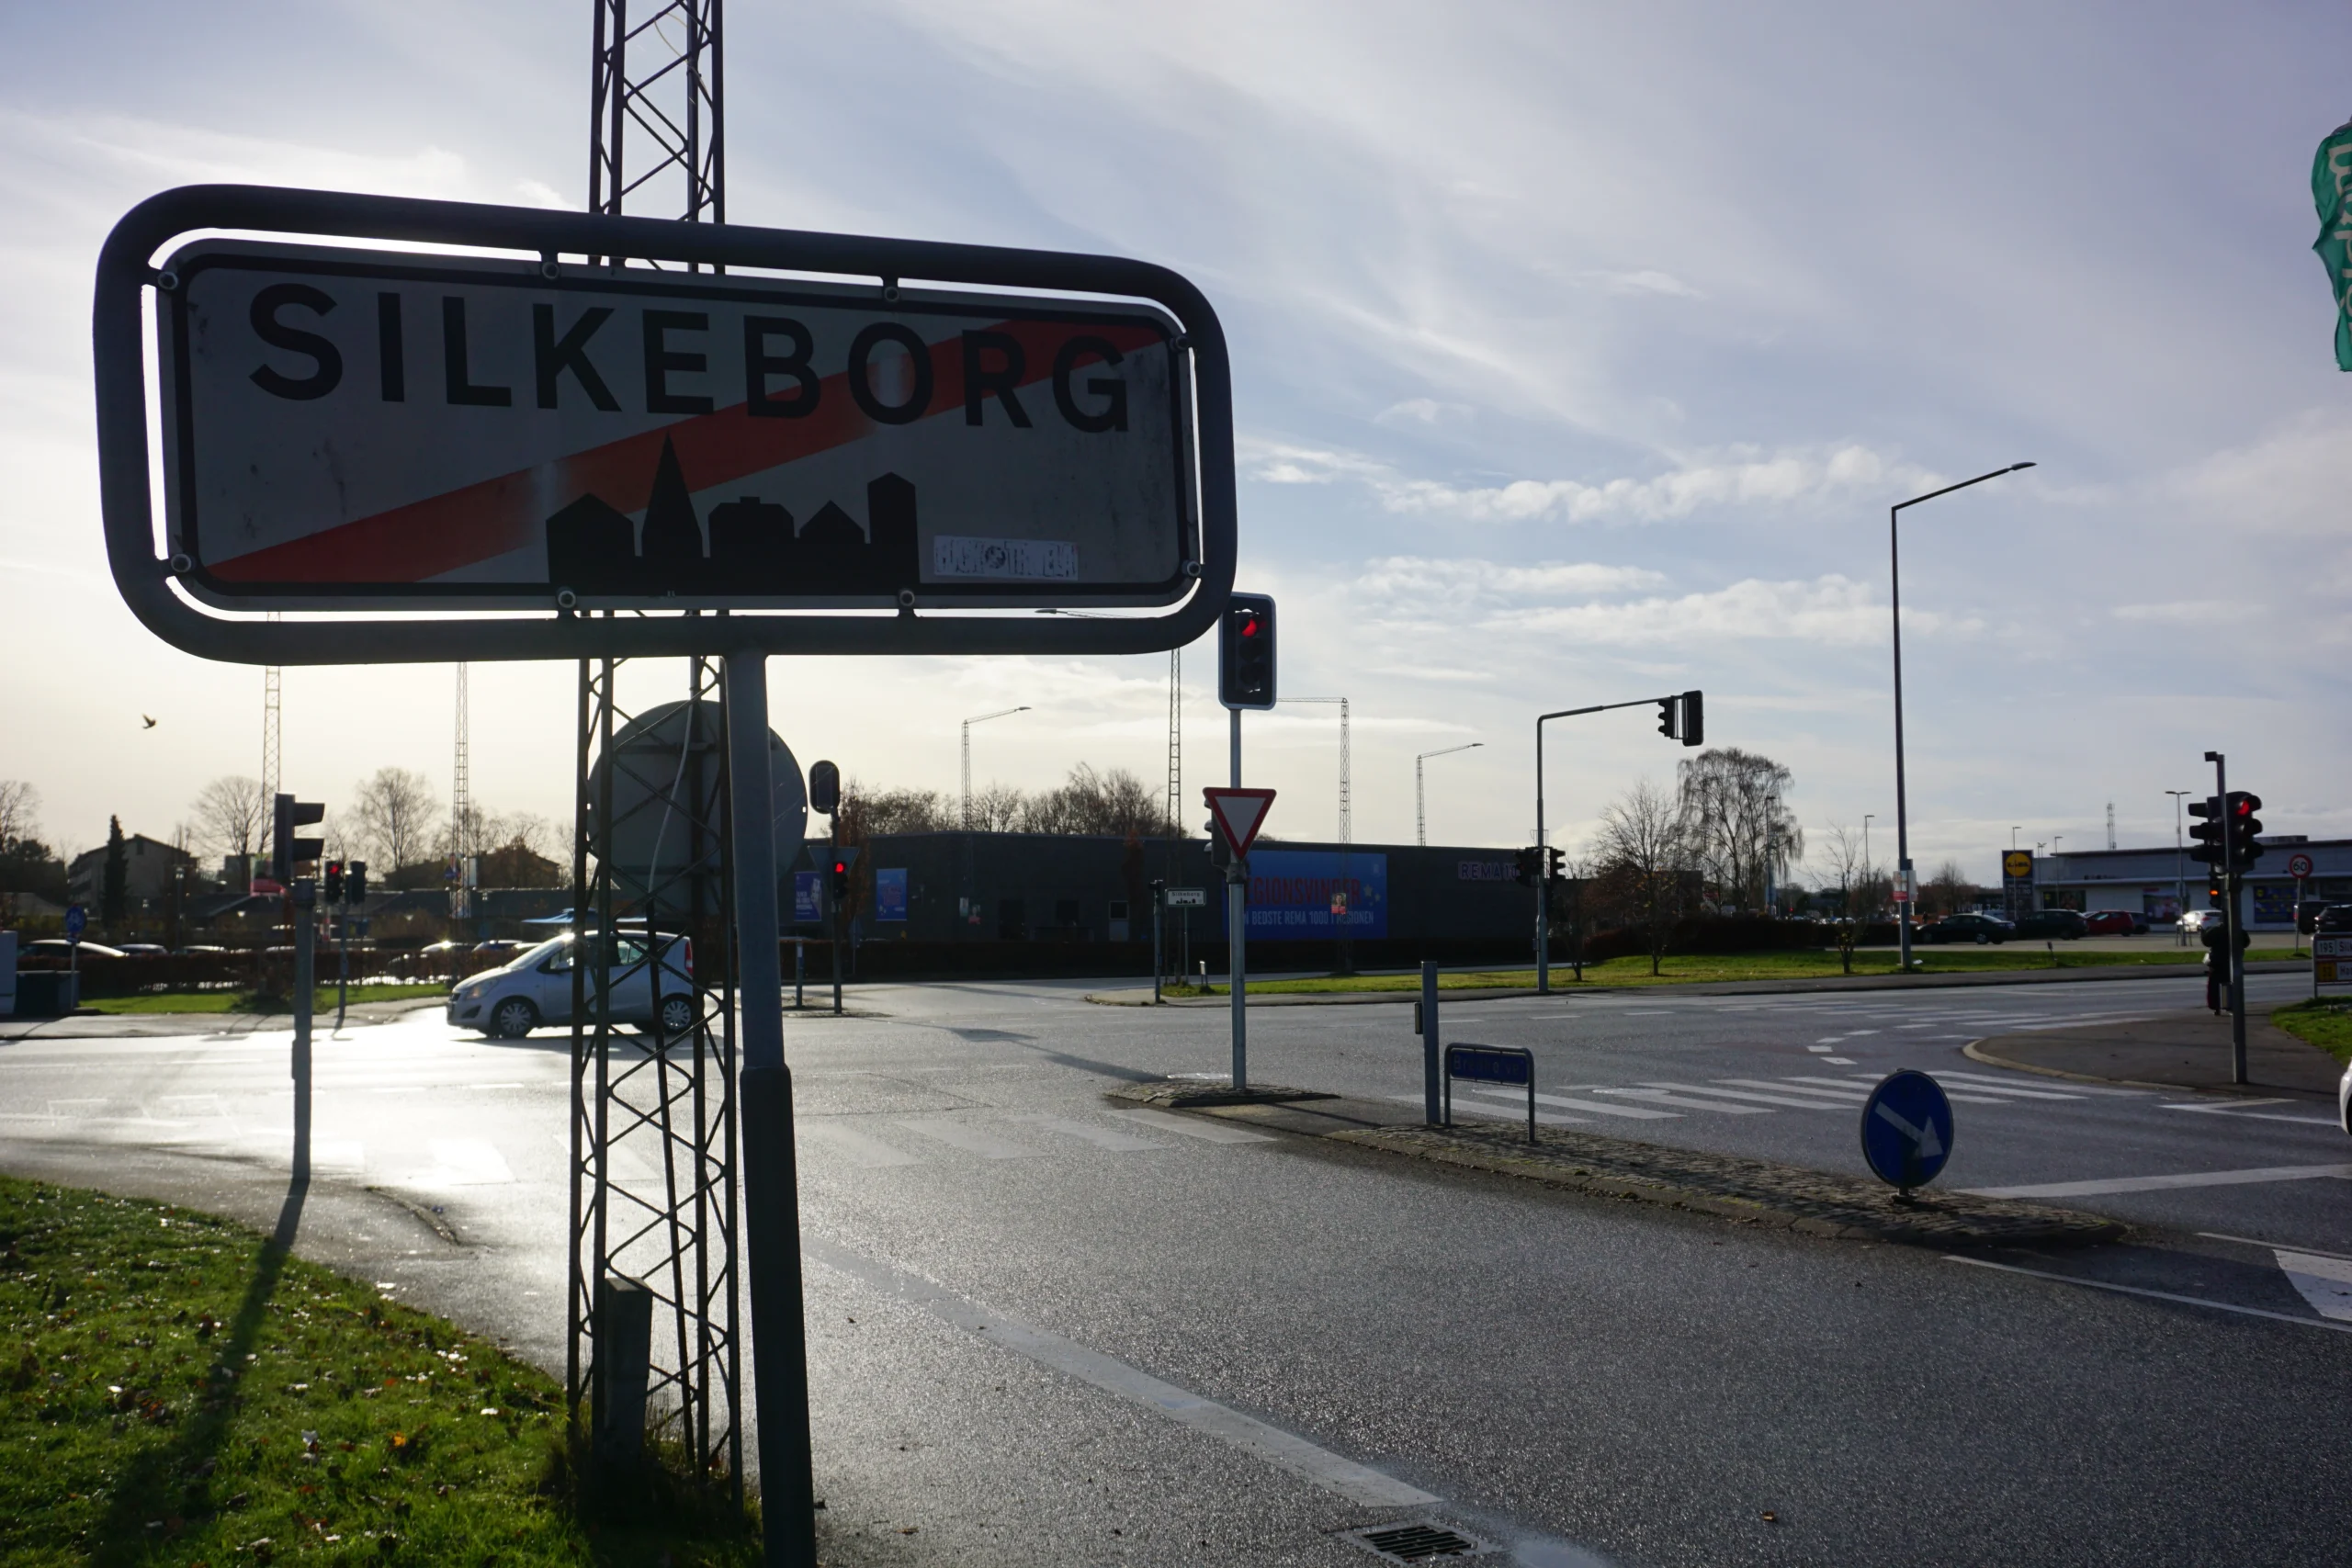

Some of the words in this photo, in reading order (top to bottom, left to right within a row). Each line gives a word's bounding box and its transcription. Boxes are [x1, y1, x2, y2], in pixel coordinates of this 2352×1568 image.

[248, 283, 1128, 433] SILKEBORG
[1460, 863, 1501, 879] REMA
[1505, 863, 1519, 879] 10
[2292, 862, 2307, 871] 60
[1245, 876, 1362, 905] EGIONSVINDER
[1251, 911, 1283, 925] BEDSTE
[1284, 911, 1306, 925] REMA
[1309, 911, 1329, 925] 1000
[1337, 911, 1374, 925] REGIONEN
[2320, 942, 2334, 953] 195
